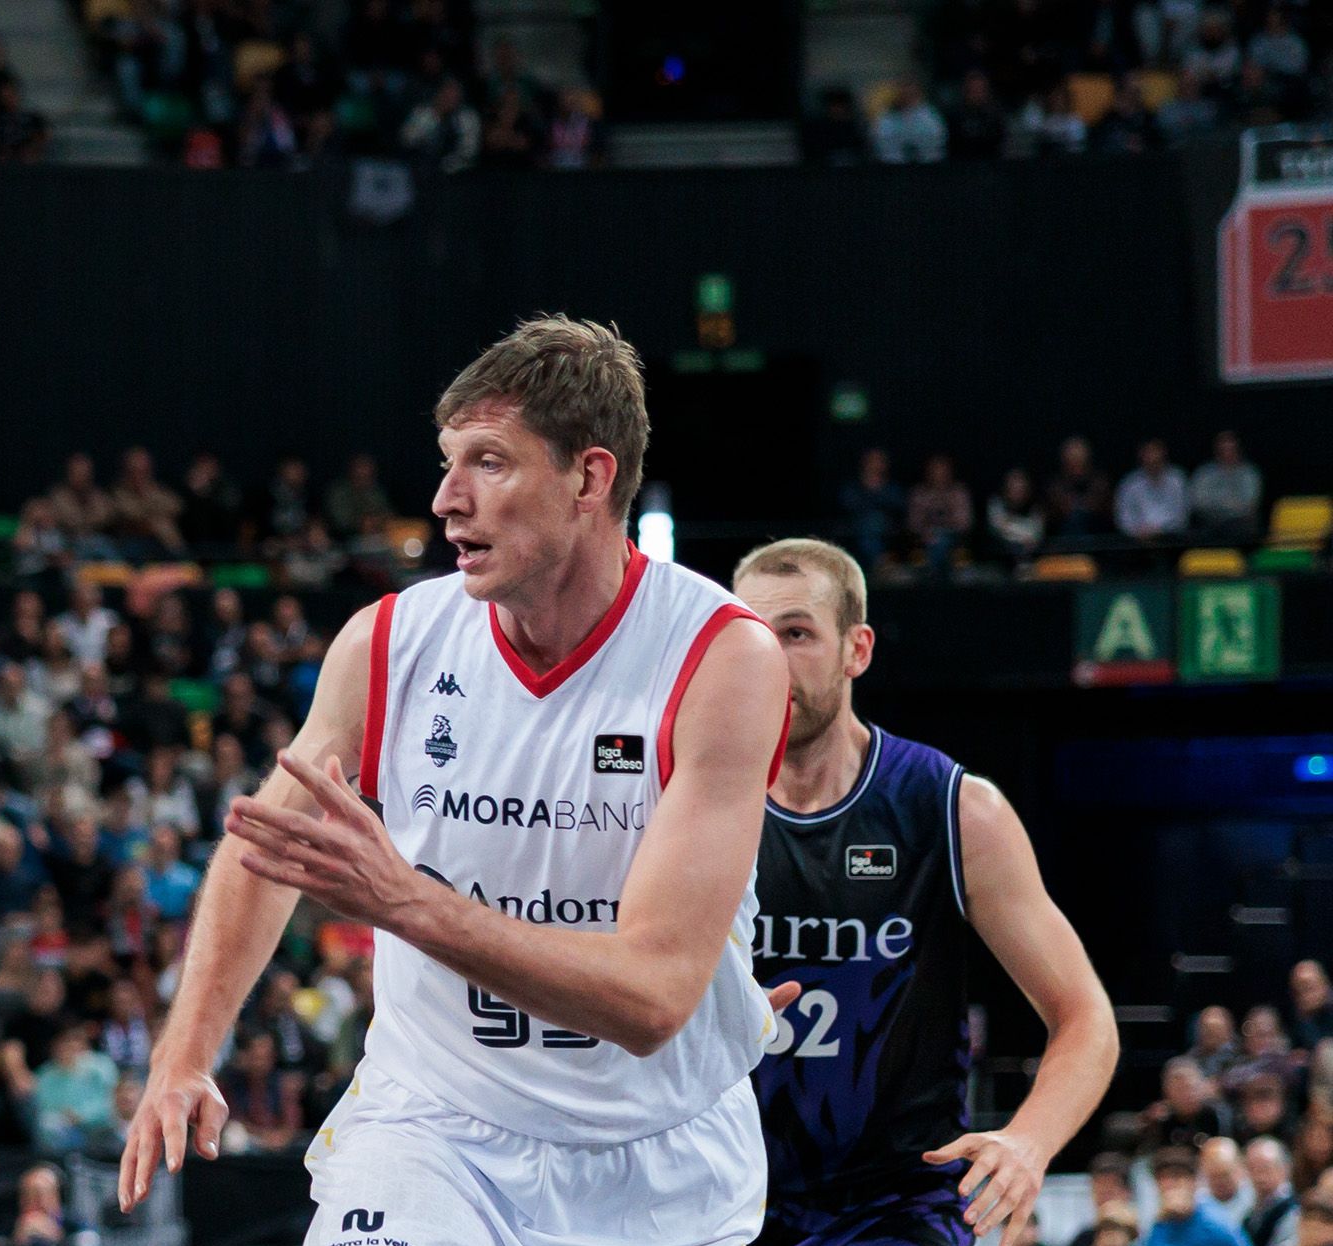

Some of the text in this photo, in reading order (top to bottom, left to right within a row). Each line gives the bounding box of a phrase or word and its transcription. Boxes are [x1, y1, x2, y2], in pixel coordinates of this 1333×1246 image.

[1266, 215, 1333, 300] 2
[1093, 592, 1157, 661] A
[598, 745, 622, 759] liga
[598, 758, 643, 770] endesa
[470, 882, 620, 924] Andorr
[753, 914, 914, 962] urne
[467, 979, 600, 1049] 9
[366, 1237, 379, 1246] la
